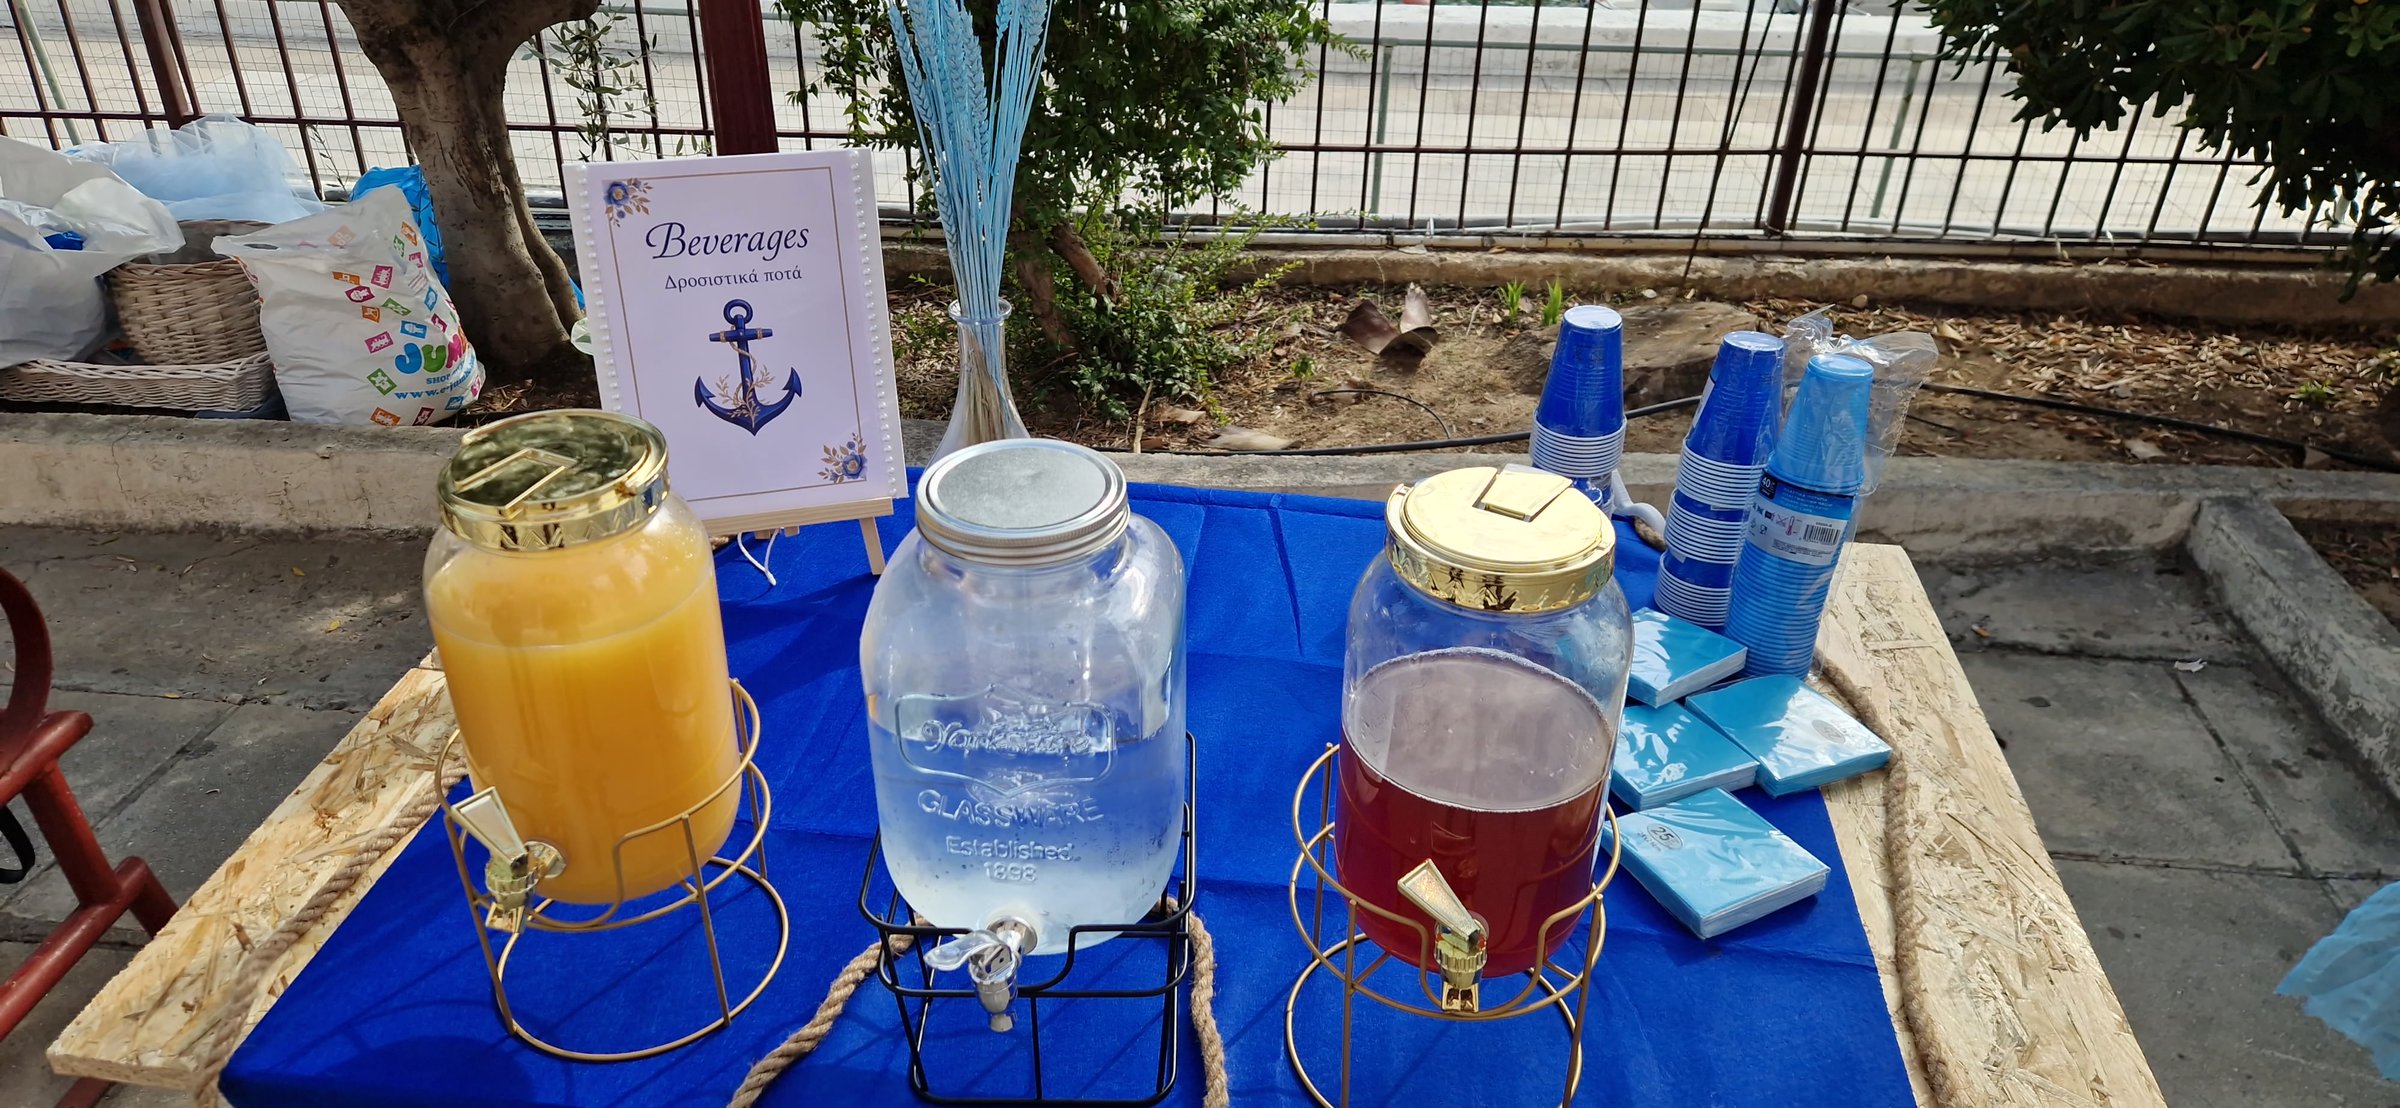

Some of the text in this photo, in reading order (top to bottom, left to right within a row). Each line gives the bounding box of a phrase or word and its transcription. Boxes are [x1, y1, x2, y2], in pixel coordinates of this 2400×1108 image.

[645, 221, 810, 262] Beverages
[664, 265, 803, 293] Δροσιστικά ποτά
[1762, 476, 1771, 488] 40
[917, 789, 1104, 829] GLASSWARE
[1650, 826, 1675, 841] 25
[945, 835, 1074, 862] Established
